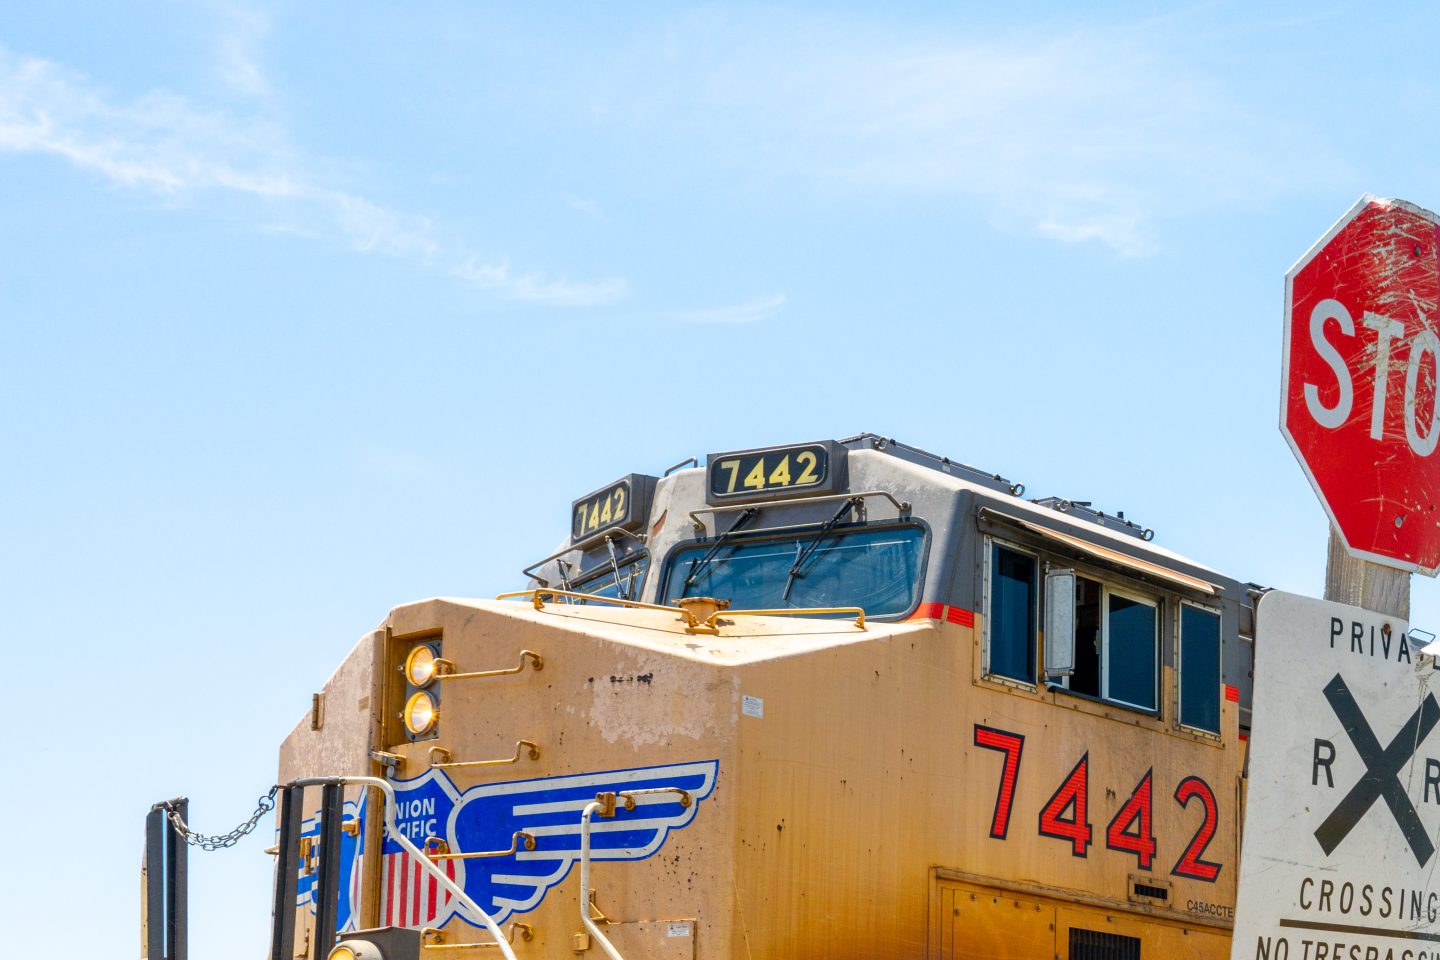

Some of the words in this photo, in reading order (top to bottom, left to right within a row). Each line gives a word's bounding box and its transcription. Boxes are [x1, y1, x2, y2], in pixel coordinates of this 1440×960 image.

[720, 450, 819, 494] 7442
[577, 486, 625, 537] 7442
[1311, 737, 1337, 789] R
[395, 797, 435, 820] NION
[974, 723, 1223, 883] 7442
[1186, 899, 1233, 918] C45ACCTE
[1299, 877, 1438, 924] CROSSING
